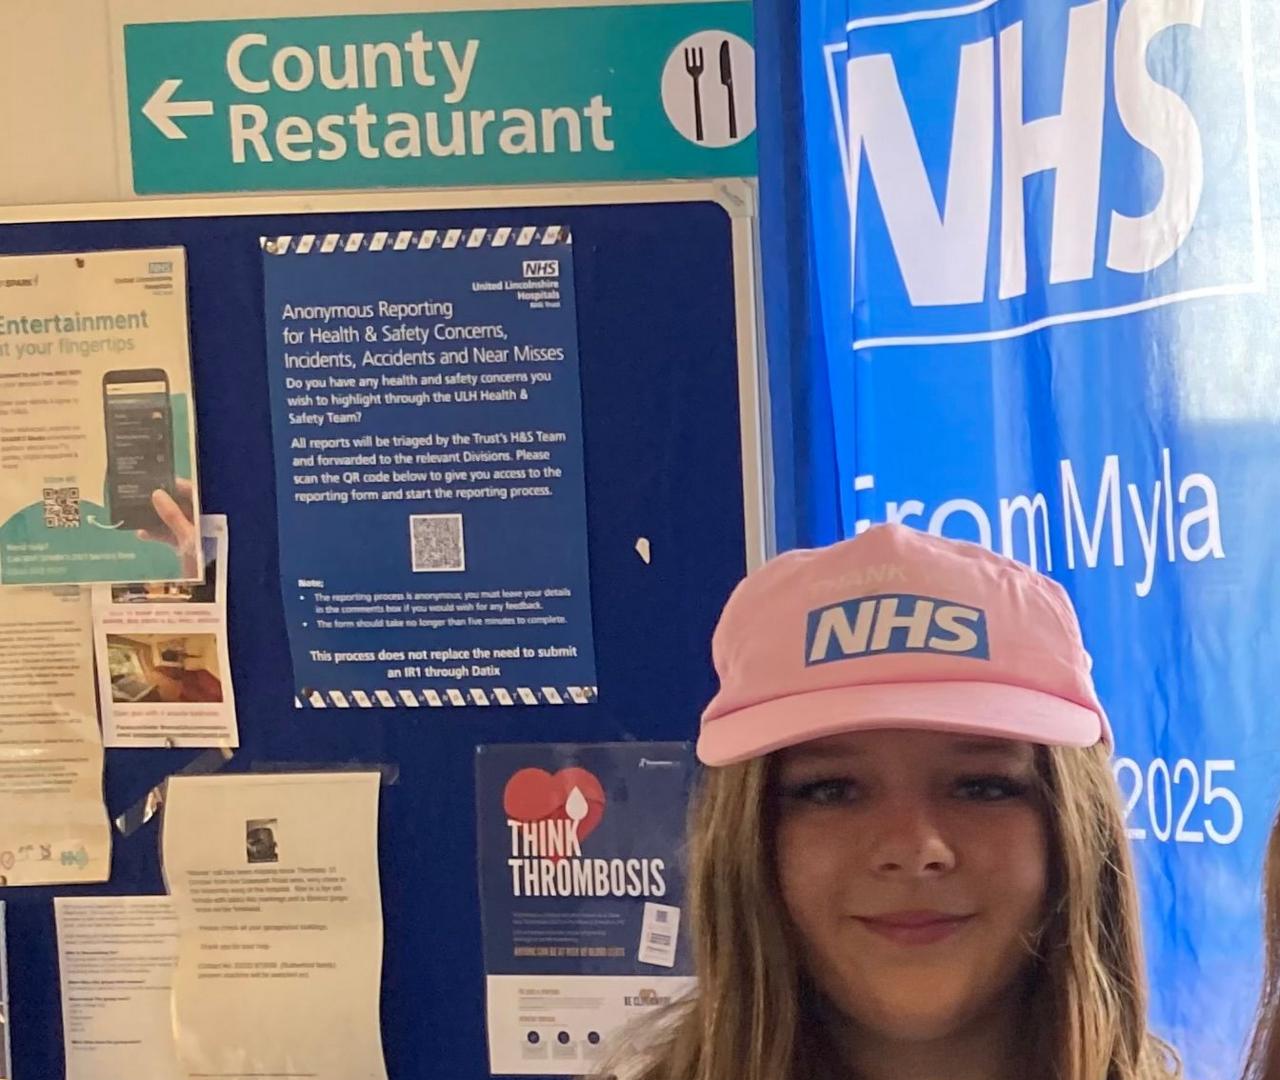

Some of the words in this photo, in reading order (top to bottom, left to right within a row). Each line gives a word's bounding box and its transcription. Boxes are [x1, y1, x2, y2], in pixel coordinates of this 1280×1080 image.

[226, 30, 480, 103] County
[229, 94, 615, 163] Restaurant
[846, 0, 1204, 307] NHS
[525, 262, 558, 276] NHS
[472, 280, 503, 292] United
[504, 279, 560, 290] Lincolnshire
[517, 289, 560, 302] Hospitals
[0, 309, 149, 335] Entertainment
[282, 304, 373, 323] Anonymous
[378, 301, 452, 320] Reporting
[282, 327, 303, 344] for
[310, 326, 359, 343] Health
[364, 325, 376, 342] &
[382, 324, 429, 344] Safety
[434, 324, 508, 342] Concerns,
[16, 341, 52, 360] your
[58, 338, 136, 358] fingertips
[284, 351, 356, 370] Incidents,
[362, 348, 435, 366] Accidents
[440, 347, 468, 364] and
[473, 347, 508, 363] Near
[514, 345, 564, 361] Misses
[286, 377, 302, 389] Do
[305, 379, 326, 390] you
[328, 376, 355, 387] have
[358, 377, 378, 389] any
[381, 374, 417, 386] health
[420, 373, 442, 385] and
[444, 372, 477, 386] safety
[480, 373, 528, 383] concerns
[530, 372, 551, 384] you
[287, 394, 313, 406] wish
[315, 395, 328, 406] to
[330, 393, 381, 408] highlight
[384, 391, 430, 406] through
[432, 391, 451, 402] the
[454, 390, 477, 402] ULH
[480, 389, 516, 401] Health
[520, 388, 528, 400] &
[288, 412, 324, 426] Safety
[326, 411, 361, 423] Team?
[291, 437, 306, 448] All
[309, 438, 350, 450] reports
[352, 435, 372, 447] will
[375, 435, 390, 447] be
[392, 434, 432, 448] triaged
[435, 434, 449, 448] by
[451, 433, 470, 445] the
[472, 432, 507, 444] Trust's
[510, 431, 533, 443] H&S
[536, 430, 566, 442] Team
[292, 454, 314, 466] and
[317, 453, 376, 466] forwarded
[378, 454, 391, 464] to
[394, 452, 412, 464] the
[415, 452, 460, 463] relevant
[462, 450, 514, 462] Divisions.
[516, 449, 550, 460] Please
[293, 475, 318, 484] scan
[320, 472, 340, 483] the
[342, 471, 360, 484] QR
[362, 470, 390, 482] code
[392, 470, 427, 482] below
[429, 471, 442, 481] to
[444, 471, 467, 483] give
[469, 470, 490, 482] you
[493, 469, 526, 479] access
[528, 468, 540, 478] to
[543, 466, 561, 477] the
[294, 490, 348, 504] reporting
[350, 488, 378, 500] form
[381, 488, 403, 500] and
[405, 489, 431, 499] start
[434, 487, 452, 498] the
[455, 487, 507, 500] reporting
[510, 486, 552, 498] process.
[1060, 447, 1226, 597] Myla
[808, 597, 980, 662] NHS
[310, 650, 332, 661] This
[334, 652, 375, 664] process
[377, 649, 405, 660] does
[408, 650, 427, 660] not
[430, 648, 470, 662] replace
[472, 647, 490, 658] the
[492, 646, 520, 658] need
[522, 647, 534, 657] to
[538, 645, 576, 657] submit
[387, 669, 401, 678] an
[404, 666, 420, 677] IR1
[424, 665, 469, 679] through
[471, 665, 500, 676] Datix
[1113, 758, 1243, 845] 2025
[507, 819, 582, 857] THINK
[508, 858, 666, 897] THROMBOSIS
